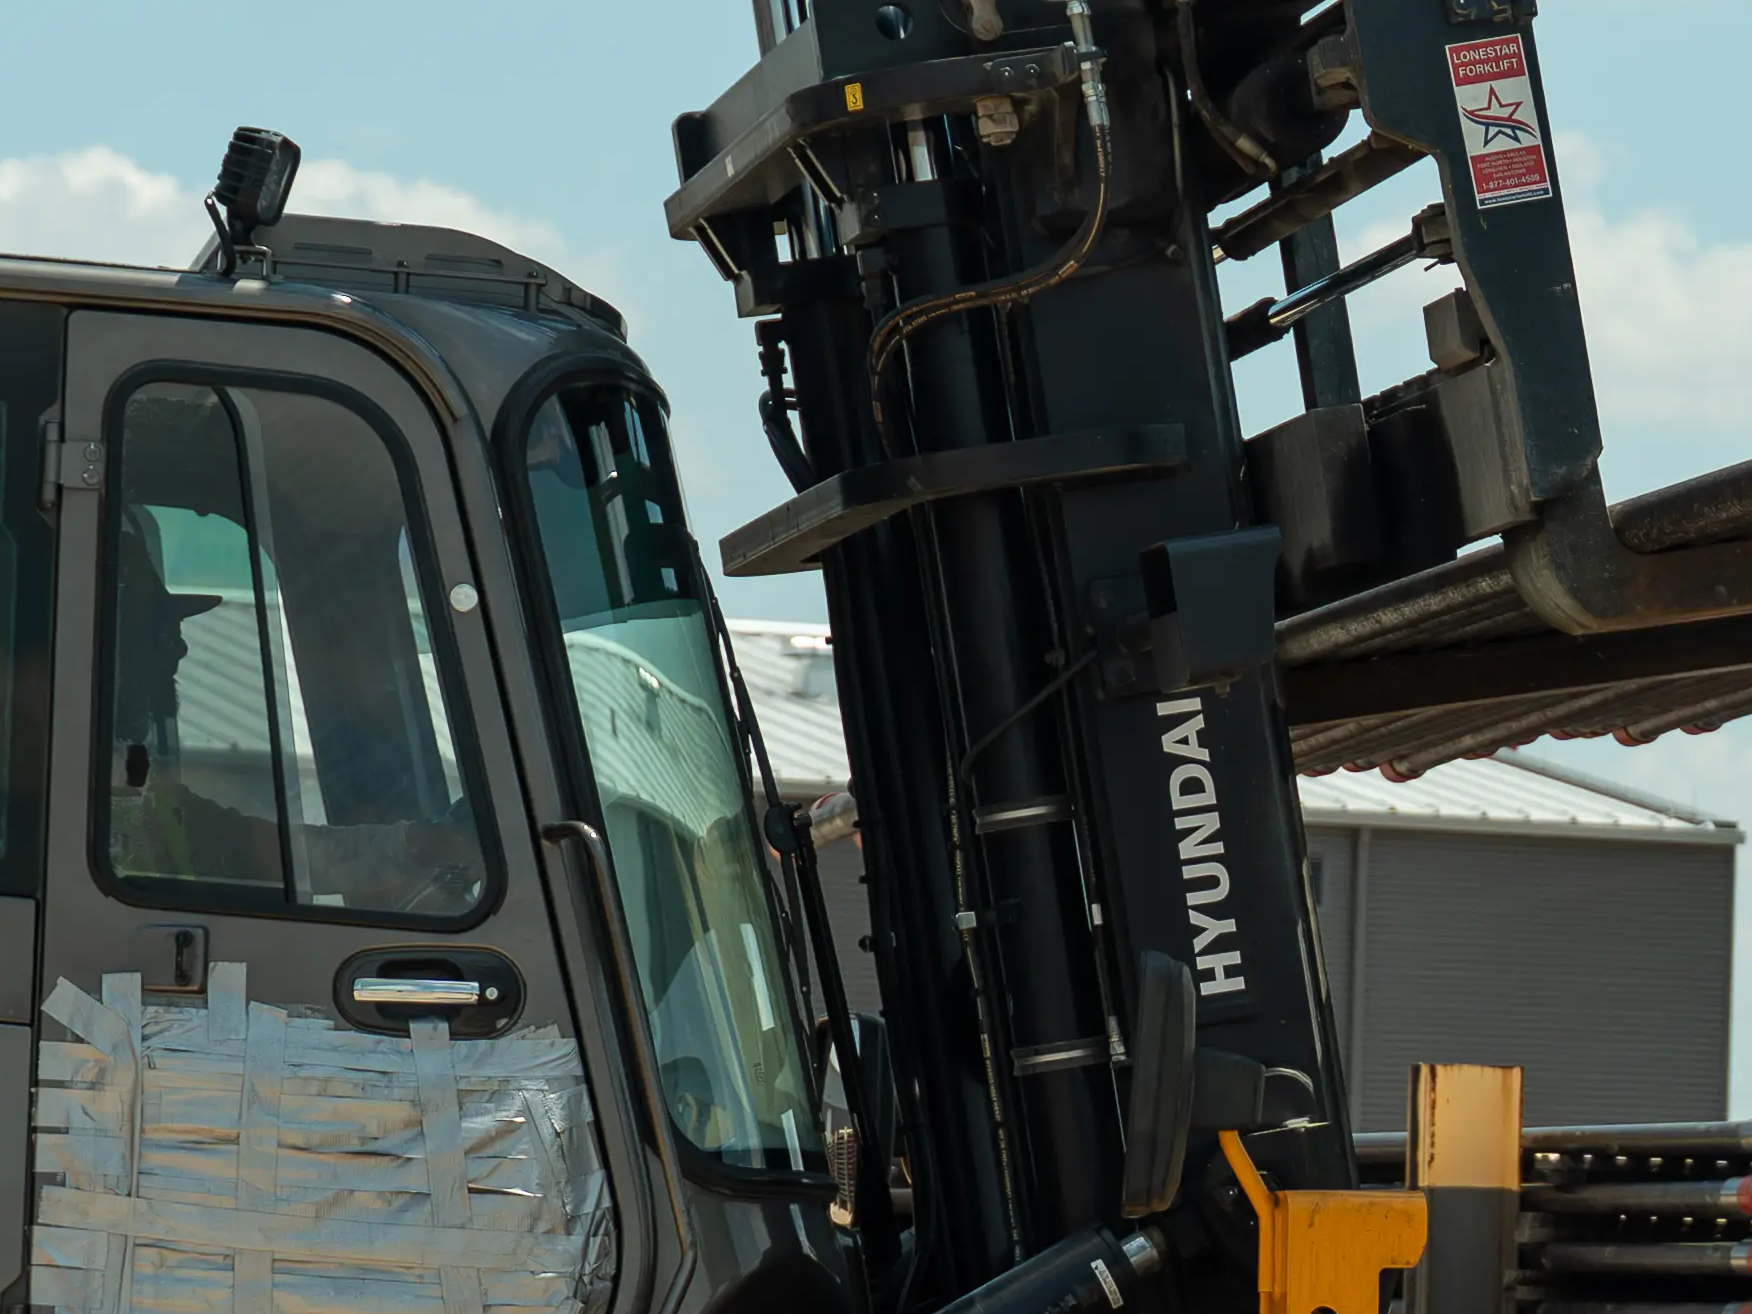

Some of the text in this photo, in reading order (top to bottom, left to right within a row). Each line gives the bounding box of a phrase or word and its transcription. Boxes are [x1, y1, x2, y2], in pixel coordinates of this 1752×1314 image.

[1453, 44, 1518, 64] LONESTAR
[1459, 58, 1518, 78] FORKLIFT
[1156, 697, 1246, 996] HYUNDAI
